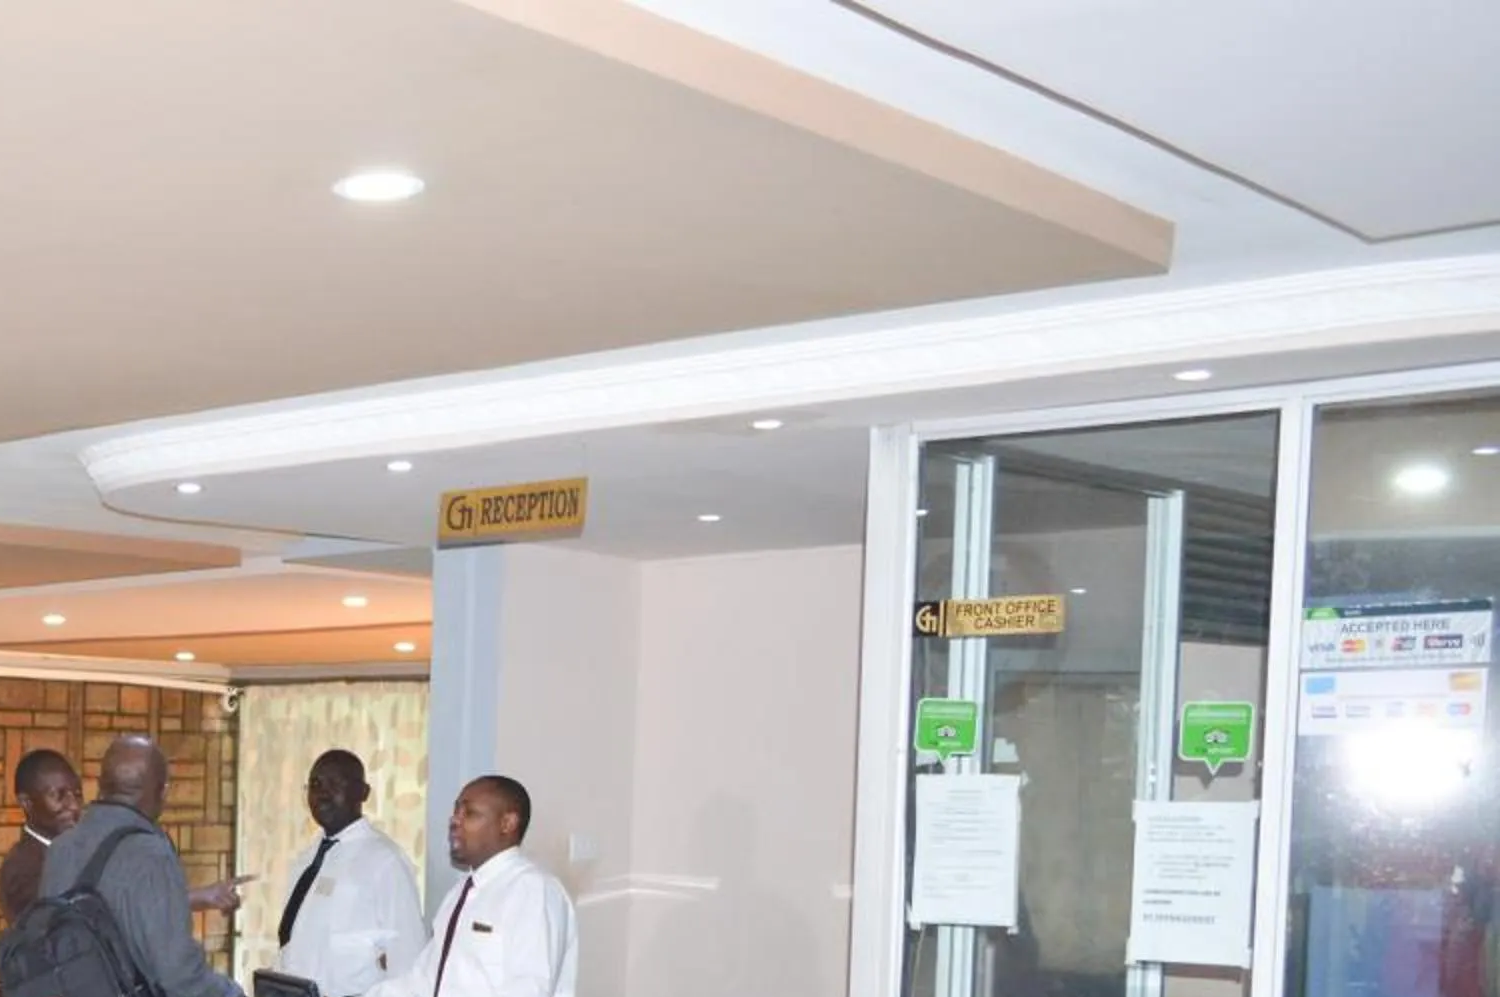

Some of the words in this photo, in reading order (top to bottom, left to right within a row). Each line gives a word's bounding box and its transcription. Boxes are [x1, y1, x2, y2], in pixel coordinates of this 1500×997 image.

[479, 487, 580, 526] RECEPTION
[955, 603, 1001, 617] FRONT
[1006, 599, 1057, 615] OFFICE
[973, 615, 1035, 630] CASHIER
[1340, 619, 1410, 634] ACCEPTED
[1412, 617, 1450, 631] HERE
